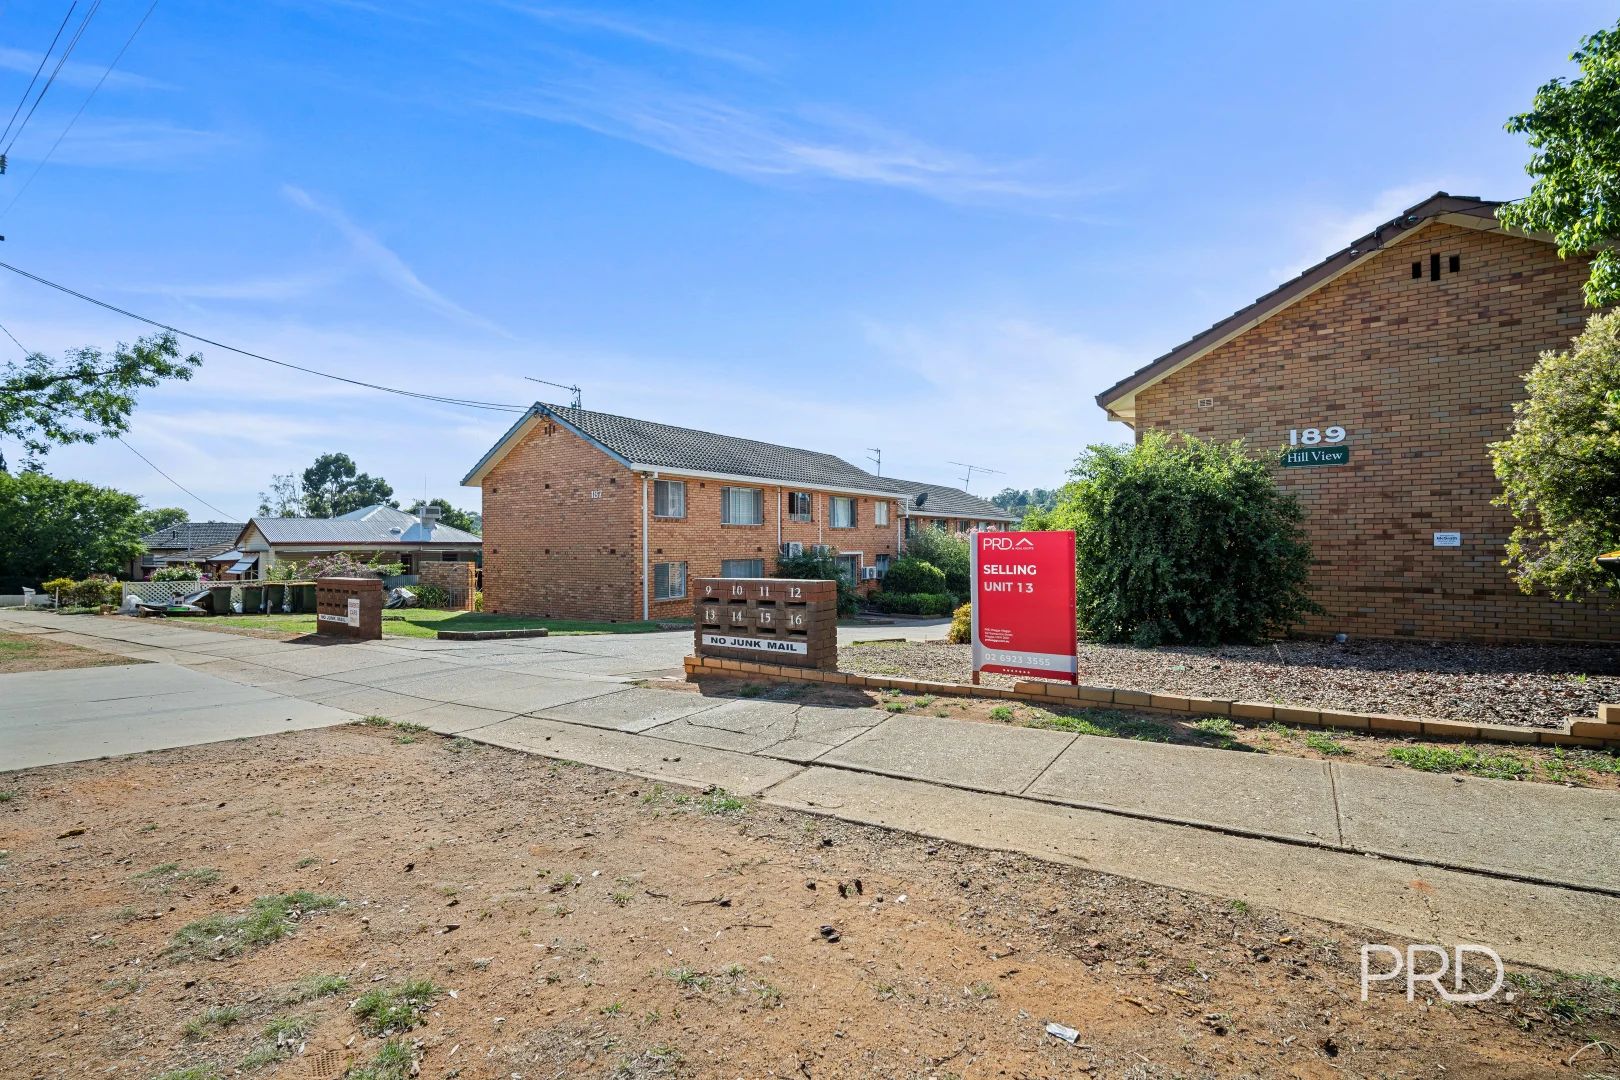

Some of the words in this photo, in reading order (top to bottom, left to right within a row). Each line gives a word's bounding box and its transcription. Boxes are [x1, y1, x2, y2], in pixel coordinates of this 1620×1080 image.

[1289, 426, 1346, 446] 189
[1287, 451, 1309, 463] Hill
[1311, 450, 1343, 461] View
[591, 490, 602, 498] 187
[983, 564, 1037, 575] SELLING
[705, 585, 712, 595] 9
[731, 585, 743, 596] 10
[760, 586, 770, 597] 11
[790, 587, 802, 598] 12
[984, 581, 1013, 592] UNIT
[705, 610, 716, 620] 13
[732, 611, 742, 622] 14
[760, 612, 771, 623] 15
[790, 614, 802, 626] 16
[711, 636, 727, 645] NO
[730, 638, 761, 648] JUNK
[767, 641, 797, 652] MAIL
[985, 653, 996, 661] 02
[1000, 654, 1023, 664] 6923
[1026, 656, 1051, 666] 3555
